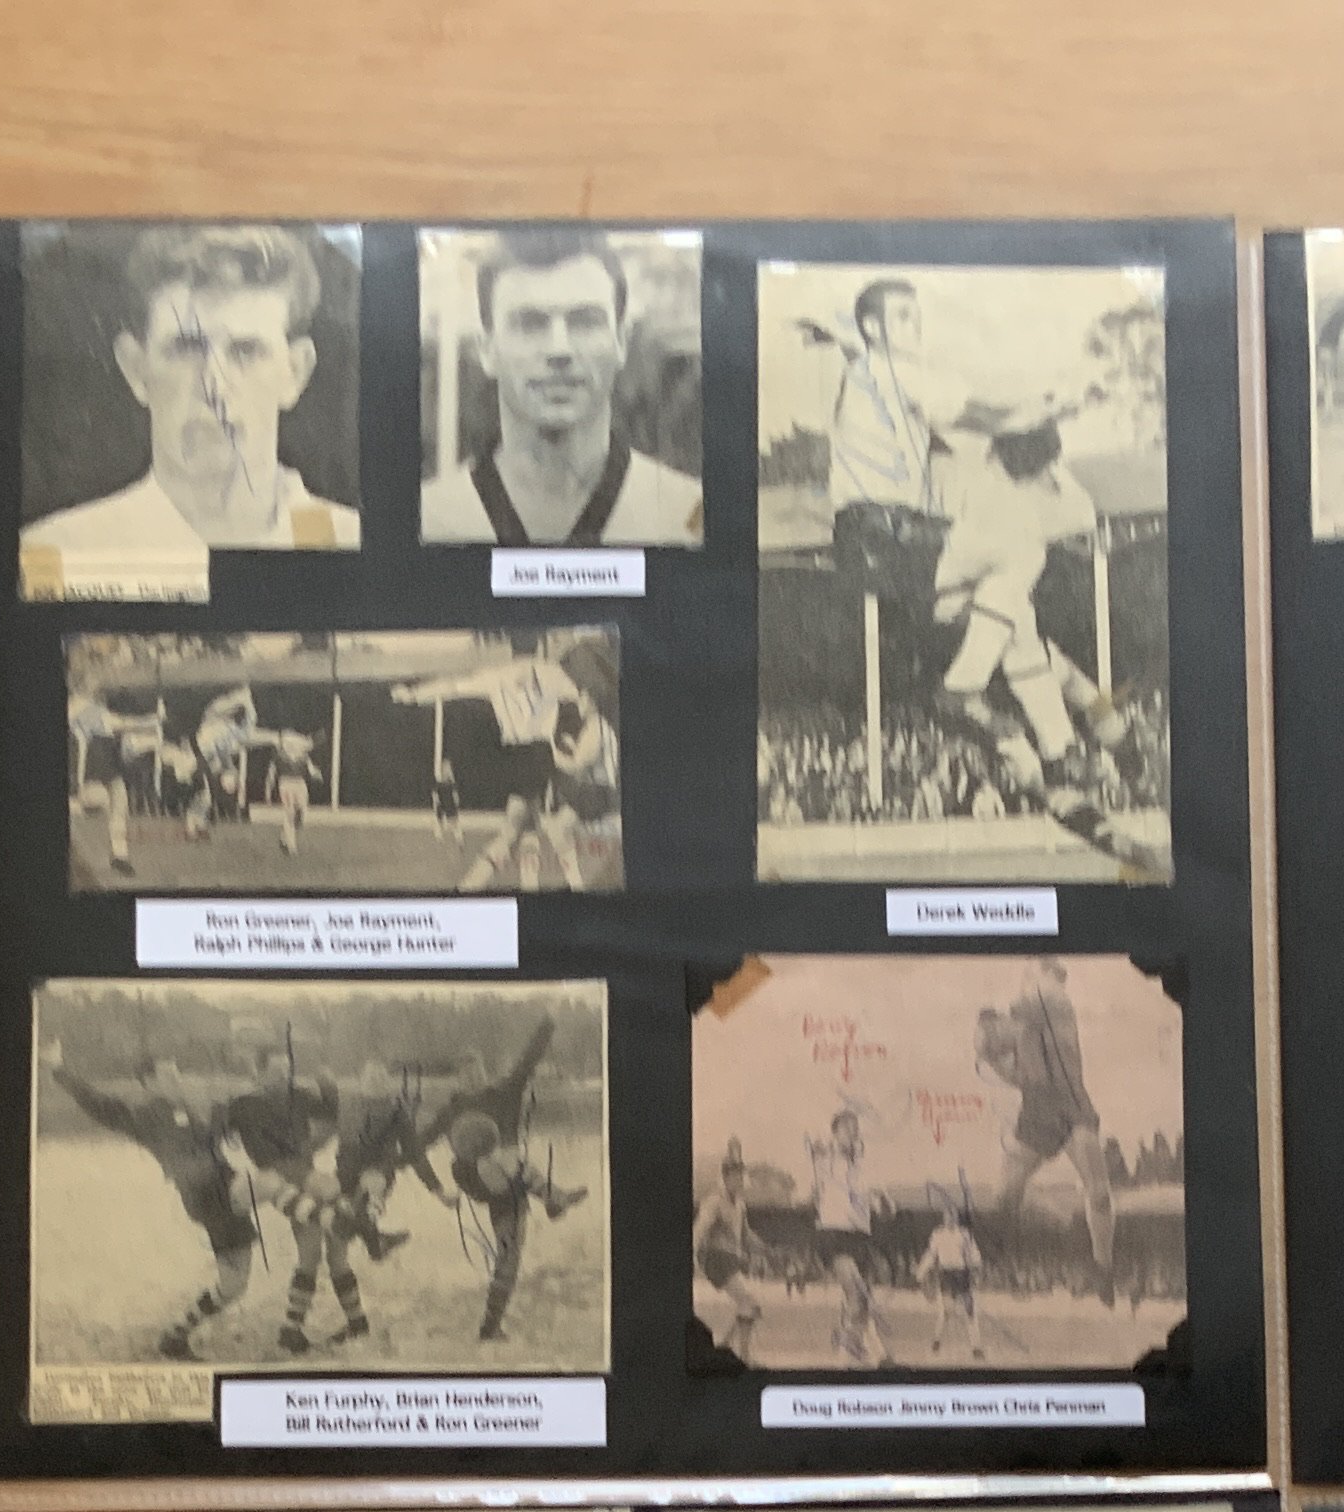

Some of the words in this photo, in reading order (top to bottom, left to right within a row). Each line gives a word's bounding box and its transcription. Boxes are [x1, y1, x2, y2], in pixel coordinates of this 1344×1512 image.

[206, 911, 239, 929] Ron
[324, 911, 353, 929] Joe
[916, 901, 965, 922] Derek
[972, 901, 1036, 922] Weddle
[194, 936, 241, 956] Ralph
[247, 934, 306, 955] Phillips
[310, 935, 324, 952] &
[330, 935, 392, 955] George
[397, 935, 456, 953] Hunter
[285, 1391, 321, 1410] Ken
[325, 1391, 389, 1415] Furphy,
[395, 1391, 440, 1410] Brian
[793, 1399, 832, 1418] Doug
[1004, 1399, 1040, 1415] Chris
[285, 1415, 312, 1432] Bill
[415, 1415, 430, 1432] &
[435, 1415, 469, 1432] Ron
[473, 1415, 543, 1432] Greener
